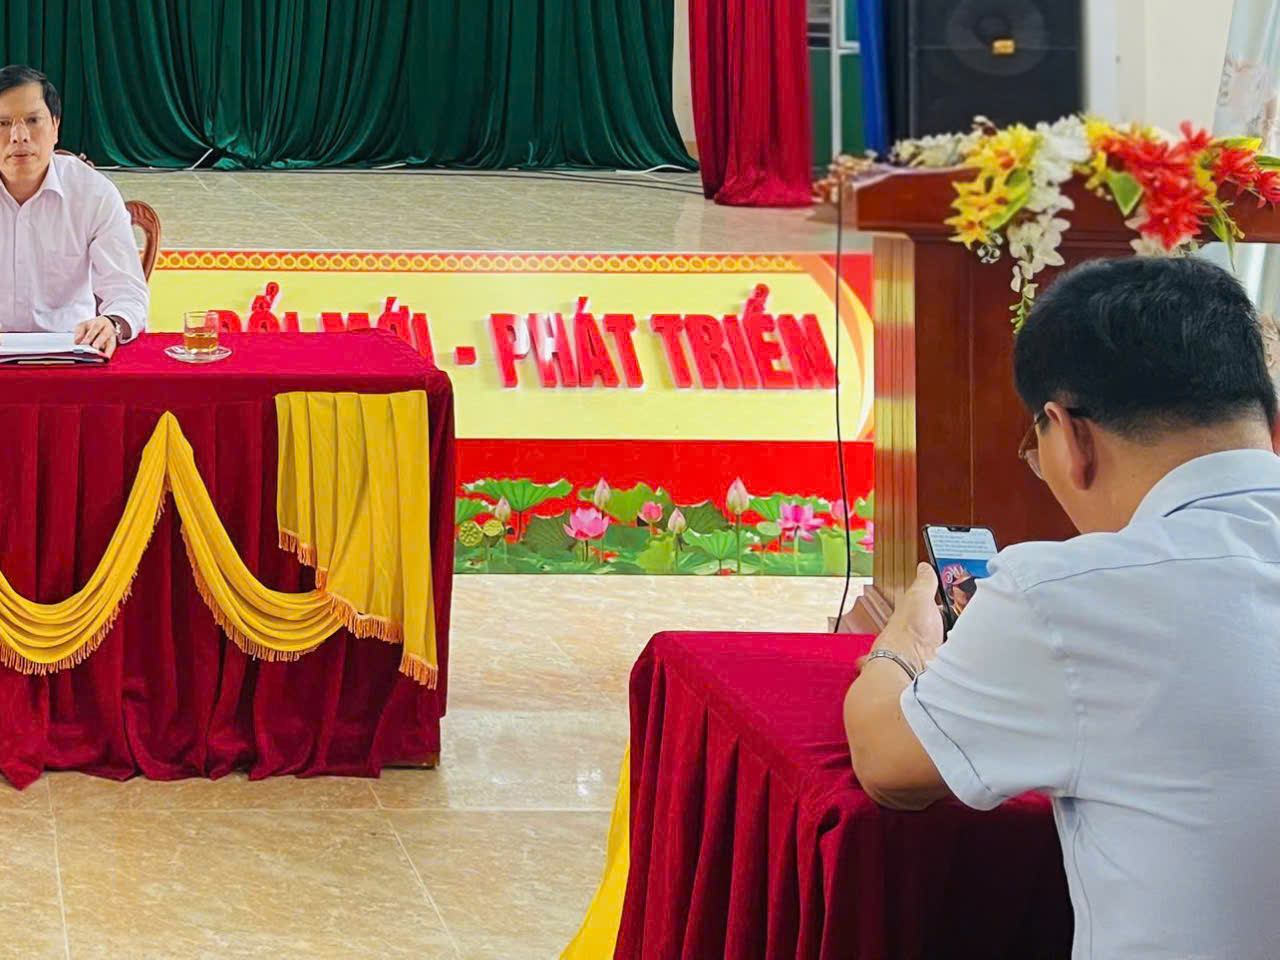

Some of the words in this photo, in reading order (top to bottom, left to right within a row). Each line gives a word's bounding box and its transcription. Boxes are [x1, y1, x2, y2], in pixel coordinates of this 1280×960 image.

[454, 344, 477, 366] -
[489, 295, 644, 388] PHÁT
[649, 283, 838, 390] TRIỂN
